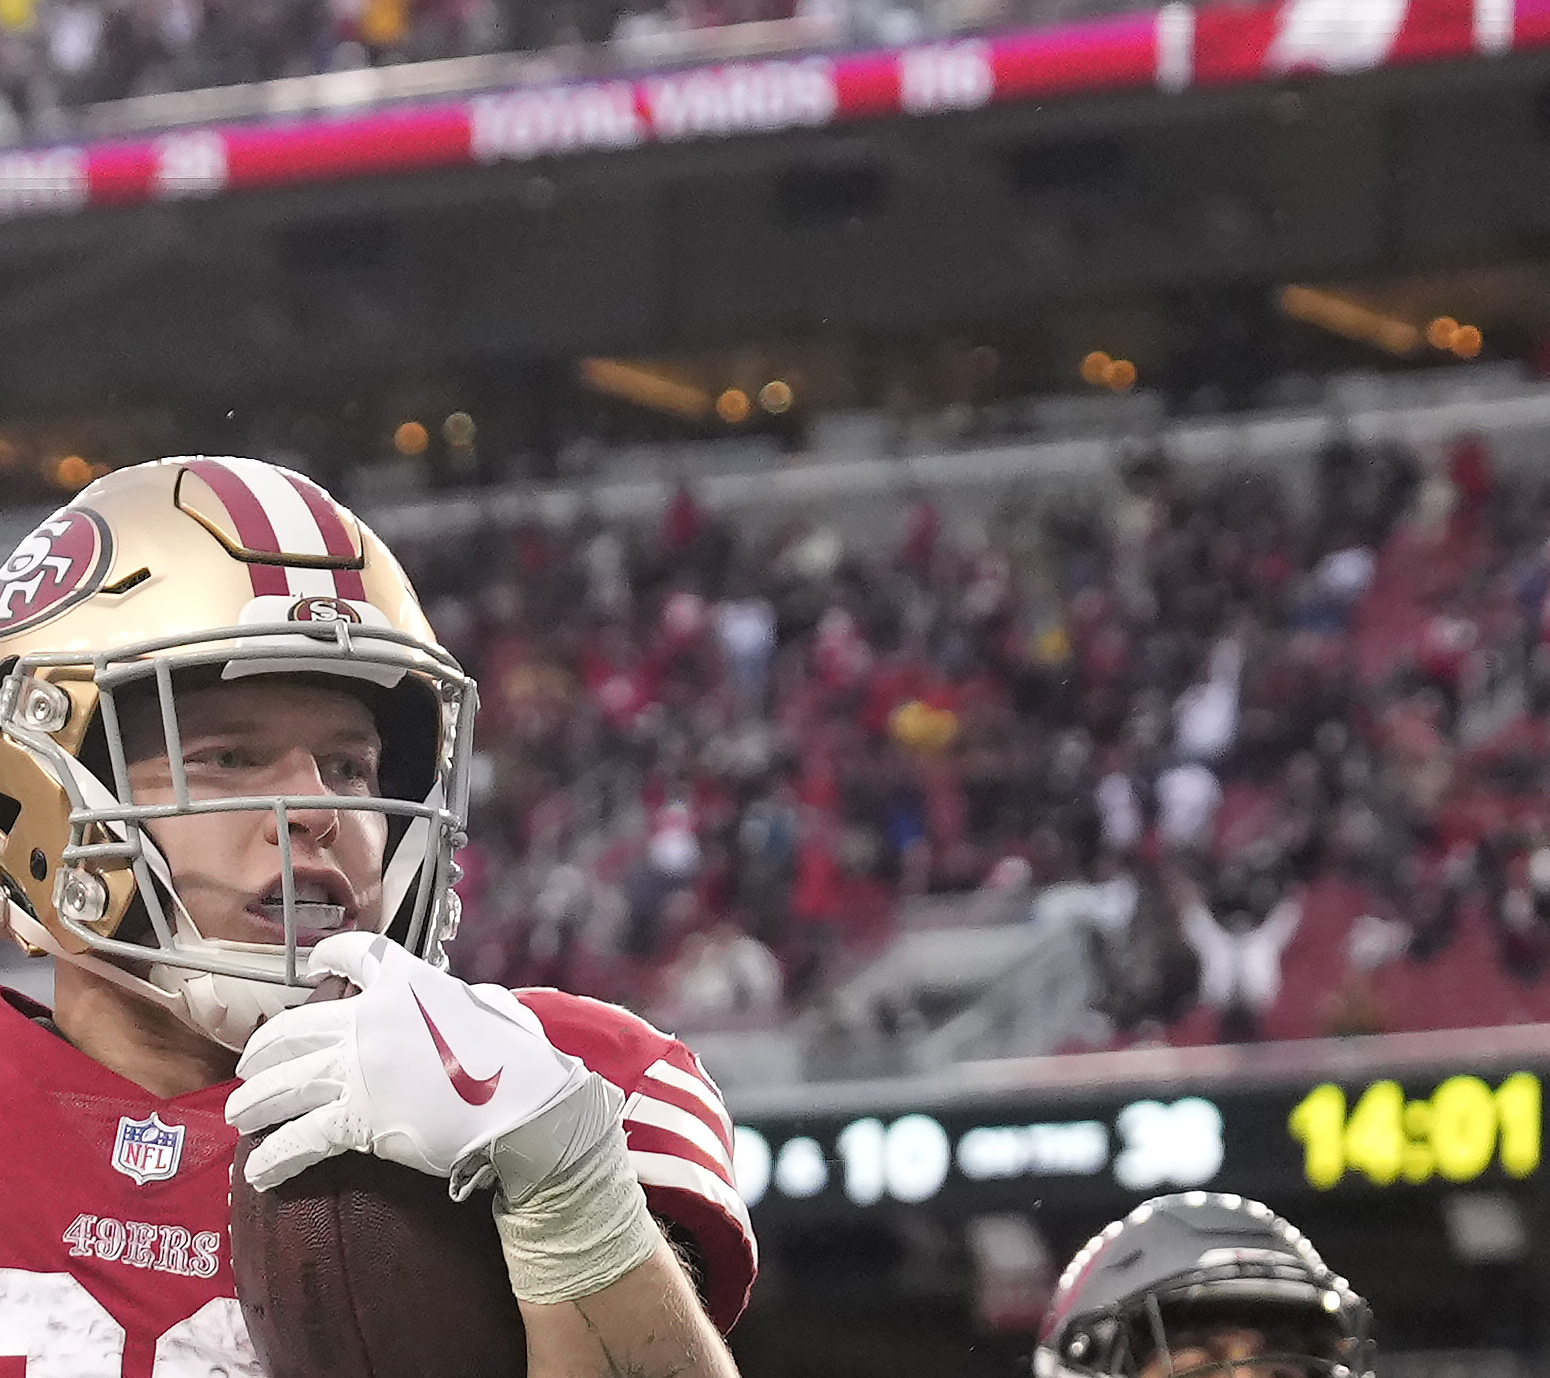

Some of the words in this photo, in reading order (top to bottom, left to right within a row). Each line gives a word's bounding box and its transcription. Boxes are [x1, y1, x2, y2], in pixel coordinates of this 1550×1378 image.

[125, 1143, 167, 1170] NFL
[837, 1114, 951, 1205] 10
[1288, 1073, 1543, 1190] 14:01
[63, 1213, 221, 1279] 49ERS
